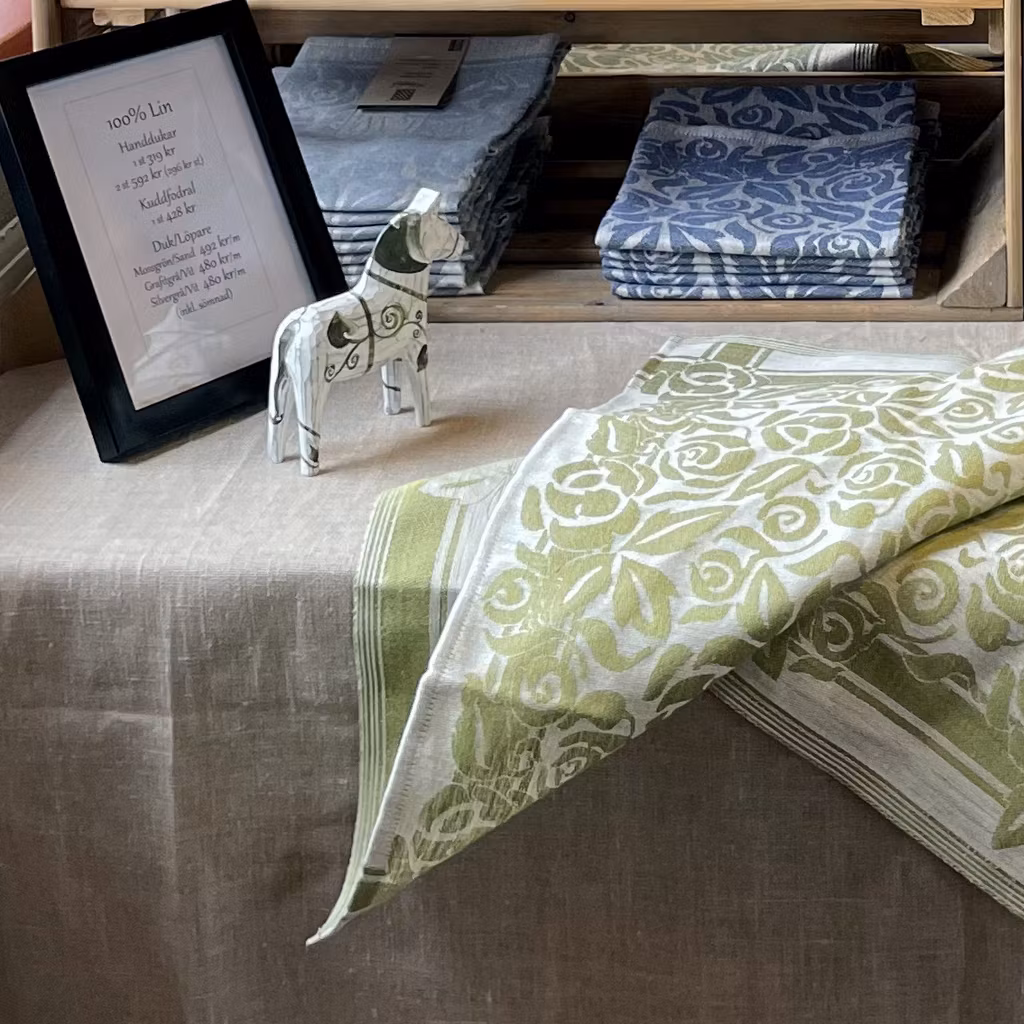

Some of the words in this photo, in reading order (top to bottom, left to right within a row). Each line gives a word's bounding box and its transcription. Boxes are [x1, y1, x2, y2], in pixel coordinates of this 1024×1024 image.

[106, 104, 148, 130] 100%
[148, 100, 174, 117] Lin
[118, 128, 177, 153] Handdukar
[138, 156, 146, 166] st
[146, 151, 163, 166] 319
[162, 144, 176, 157] kr
[115, 184, 121, 192] 2
[121, 179, 130, 190] st
[131, 174, 149, 190] 592
[149, 167, 162, 180] kr
[182, 159, 192, 169] kr
[138, 180, 197, 210] Kuddfodral
[156, 214, 164, 224] st
[166, 206, 183, 223] 428
[183, 201, 196, 214] kr
[152, 226, 212, 253] Duk/Löpare
[133, 247, 196, 277] Mossgrön/Sand
[200, 241, 217, 257] 492
[217, 234, 241, 247] kr/m
[199, 259, 217, 275] 480
[217, 251, 242, 265] kr/m
[203, 275, 222, 291] 480
[221, 268, 246, 281] kr/m
